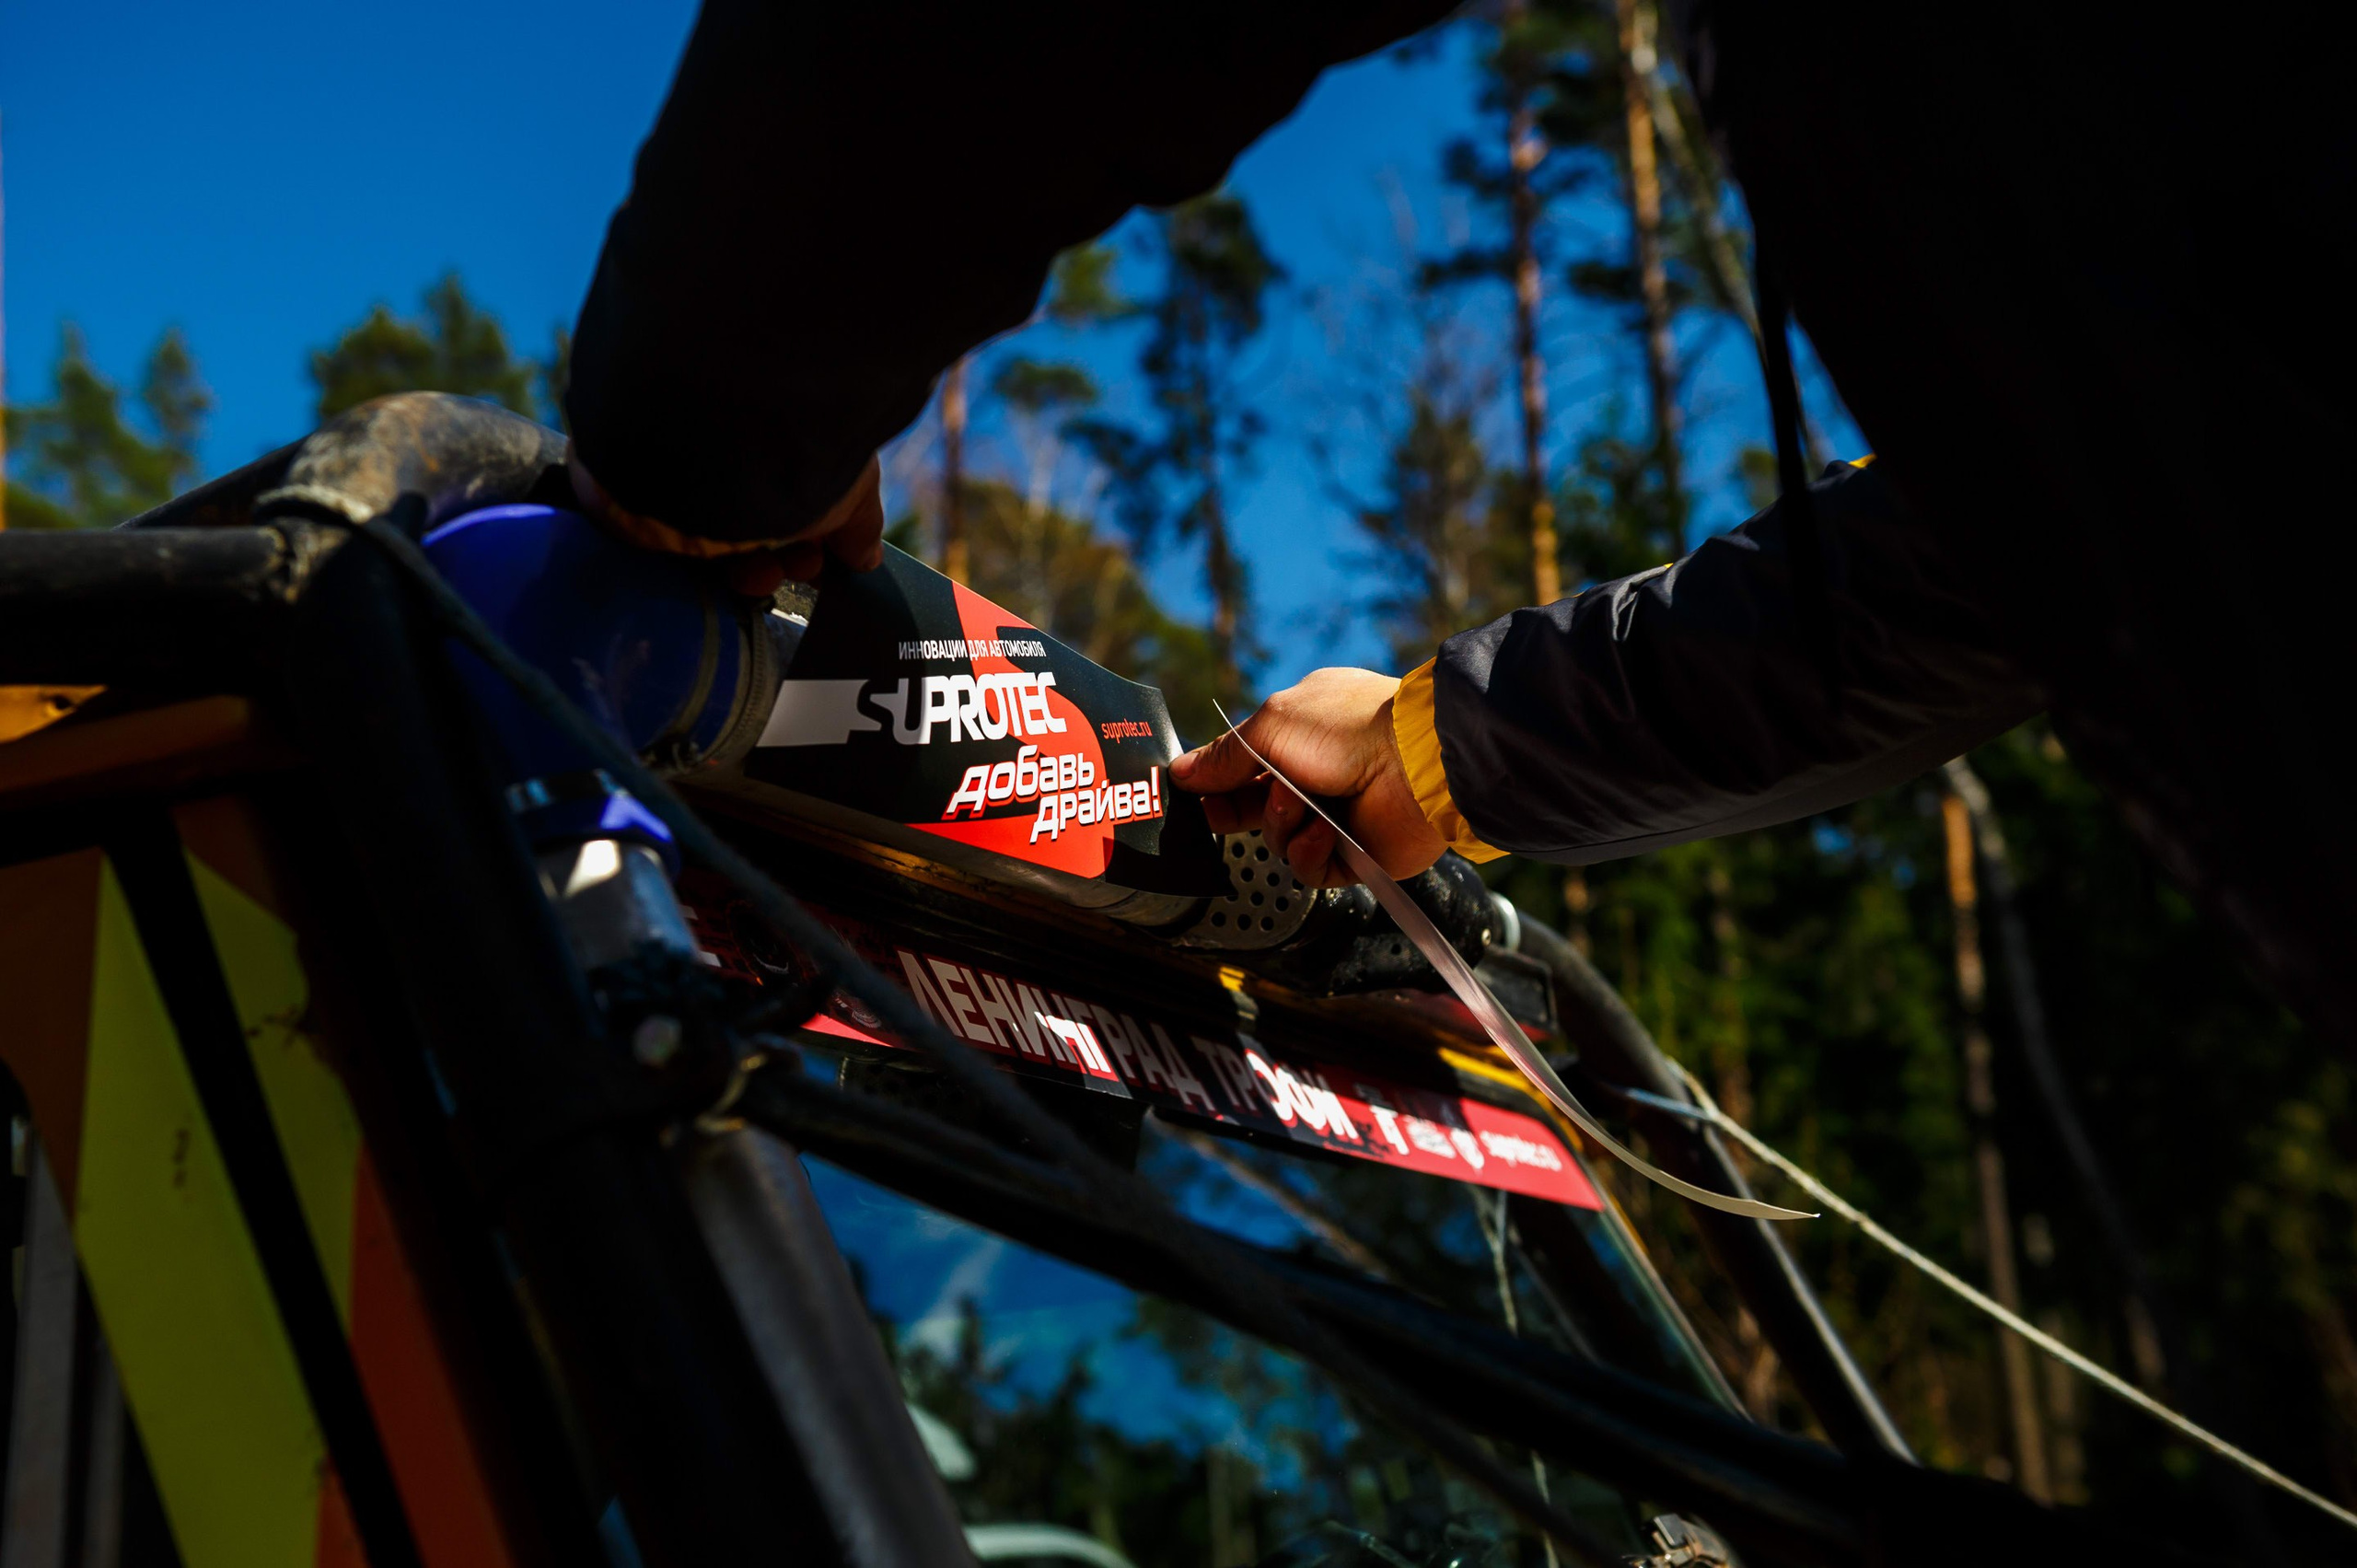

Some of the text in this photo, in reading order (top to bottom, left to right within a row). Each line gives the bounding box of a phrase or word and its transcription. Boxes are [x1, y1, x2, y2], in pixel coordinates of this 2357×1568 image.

[898, 639, 1047, 662] ИННОВАЦИИ ДЛЯ АВТОМОБИЛЯ
[856, 671, 1068, 746] SUPROTEC
[1101, 720, 1153, 740] suprotec.ru
[898, 949, 1216, 1112] ЛЕНИНГРАД
